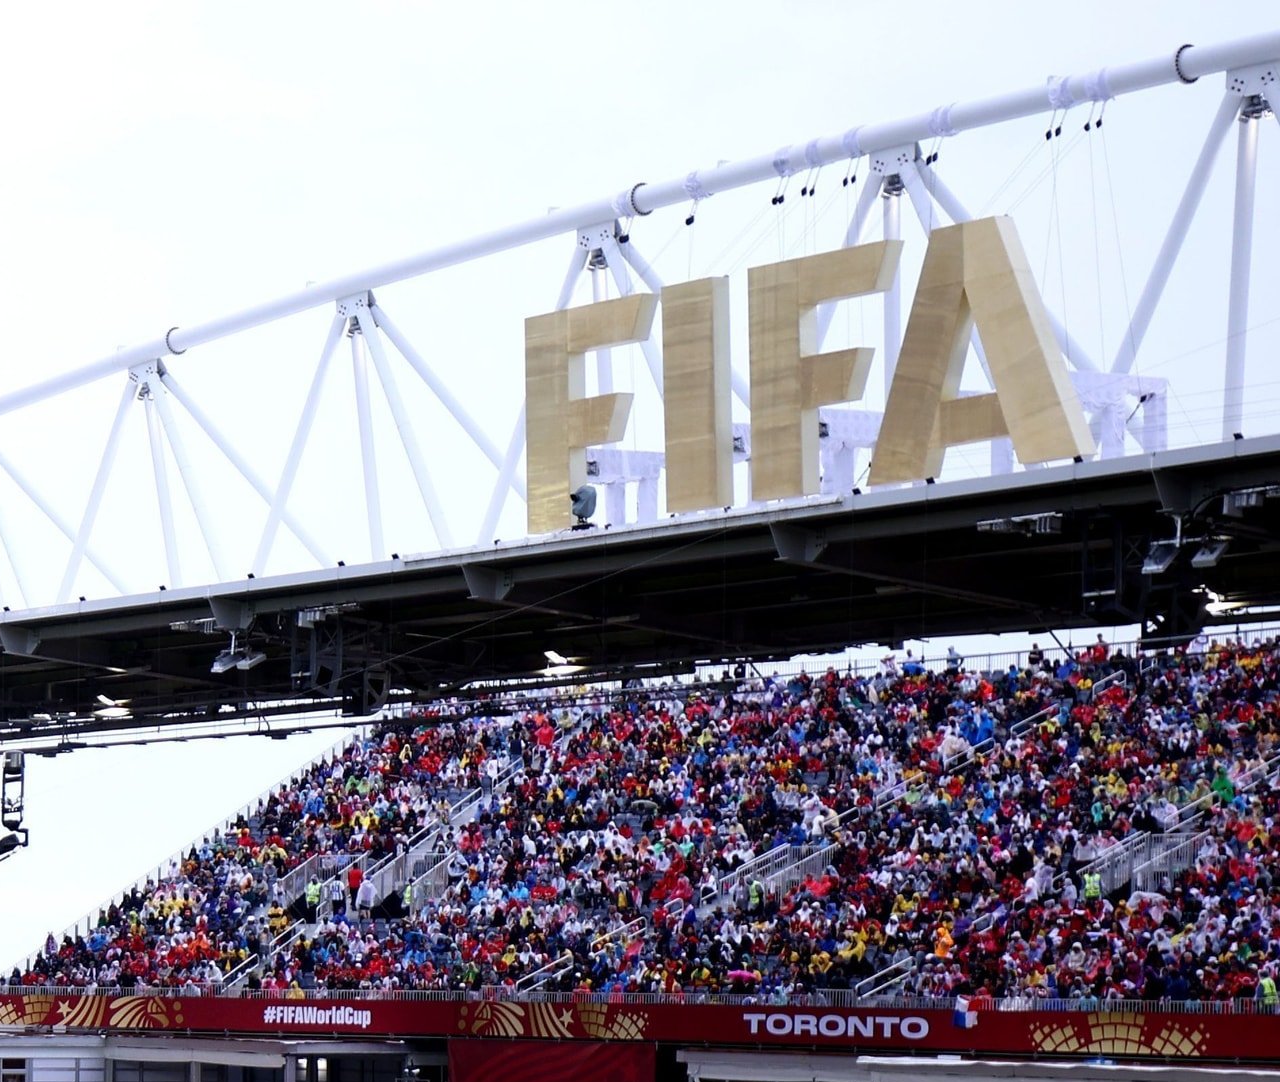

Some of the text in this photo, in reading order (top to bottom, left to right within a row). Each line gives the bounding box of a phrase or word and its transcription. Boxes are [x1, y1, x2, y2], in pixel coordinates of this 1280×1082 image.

[524, 214, 1097, 535] FIFA
[263, 1004, 372, 1029] #FIFAWorldCup
[743, 1012, 930, 1041] TORONTO
